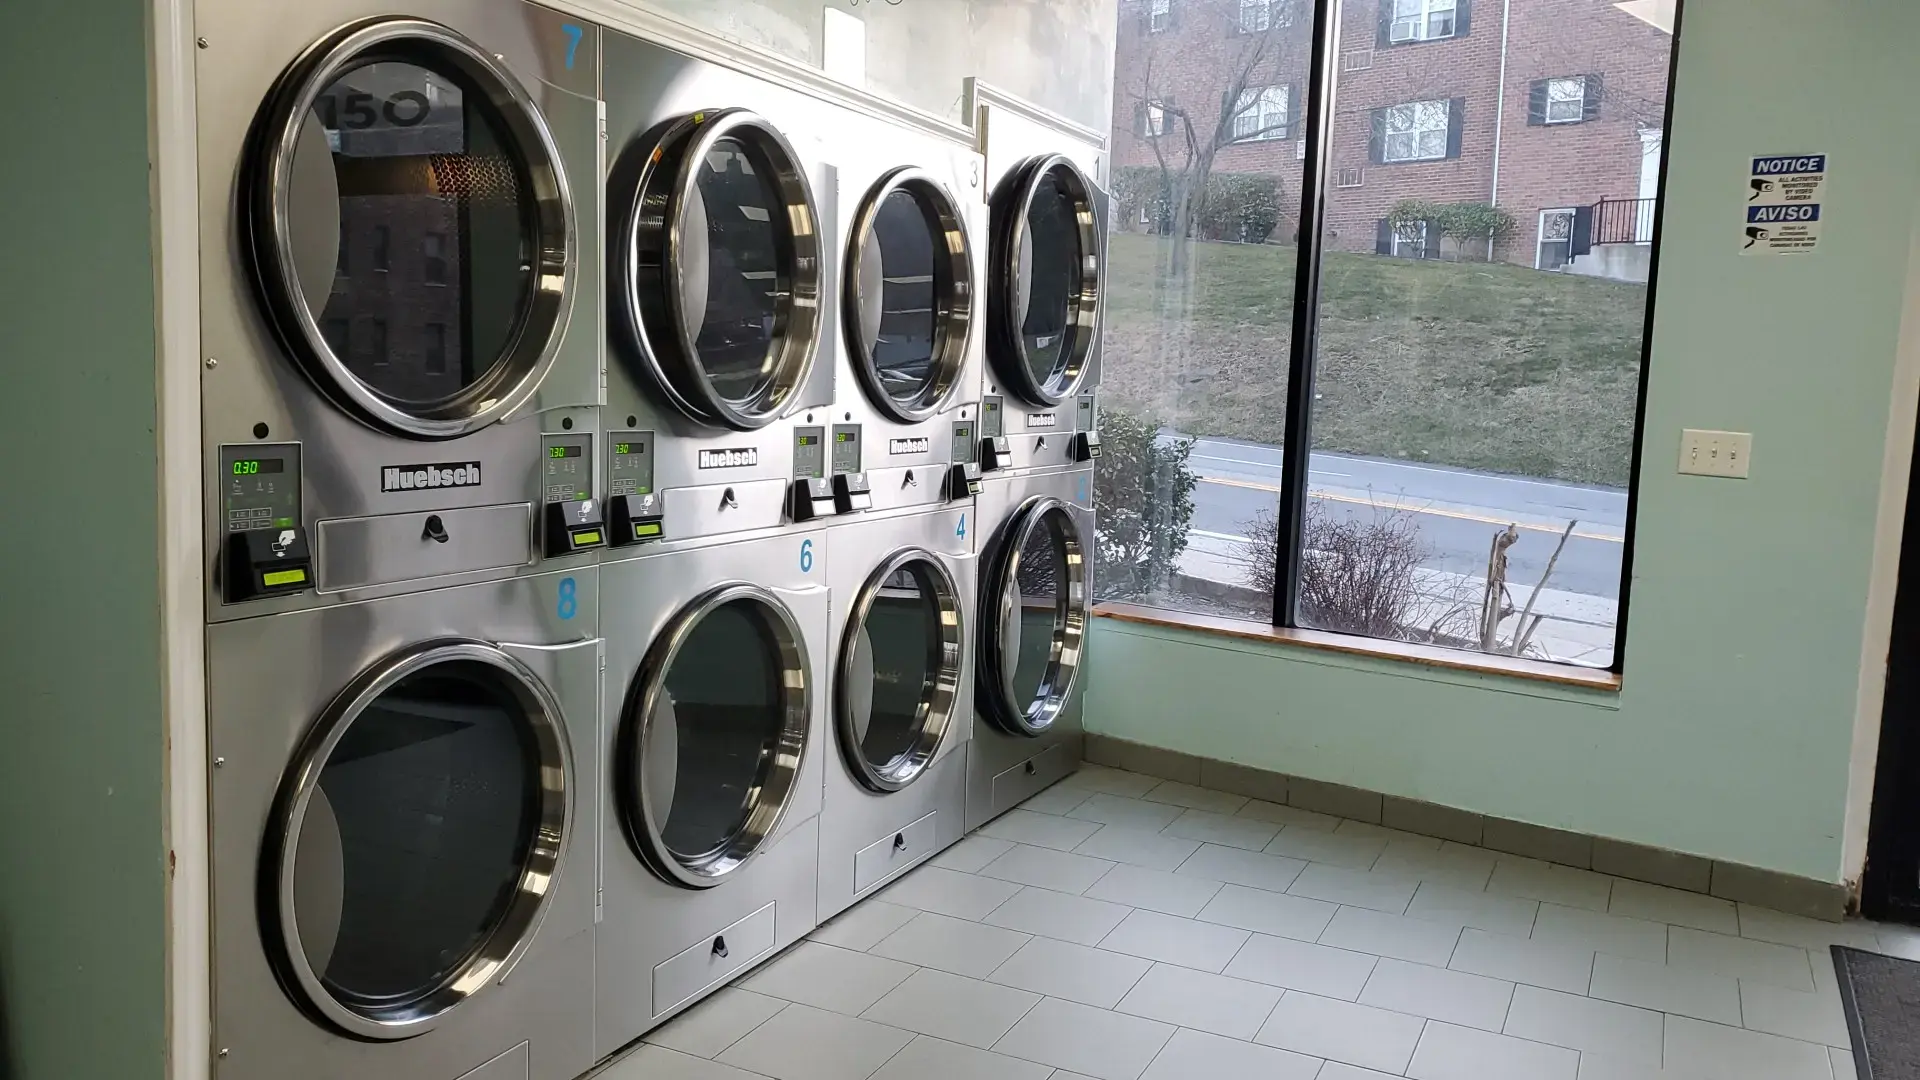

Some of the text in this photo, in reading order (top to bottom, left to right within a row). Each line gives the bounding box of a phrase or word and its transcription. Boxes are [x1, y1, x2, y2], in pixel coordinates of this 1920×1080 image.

[561, 23, 583, 70] 7
[970, 160, 978, 188] 3
[1095, 156, 1100, 180] 1
[1757, 158, 1820, 173] NOTICE
[1755, 206, 1813, 221] AVISO
[700, 448, 757, 468] Huebsch
[890, 438, 927, 454] Huebsch
[383, 463, 480, 490] Huebsch
[956, 512, 966, 541] 4
[800, 538, 813, 573] 6
[557, 576, 577, 620] 8
